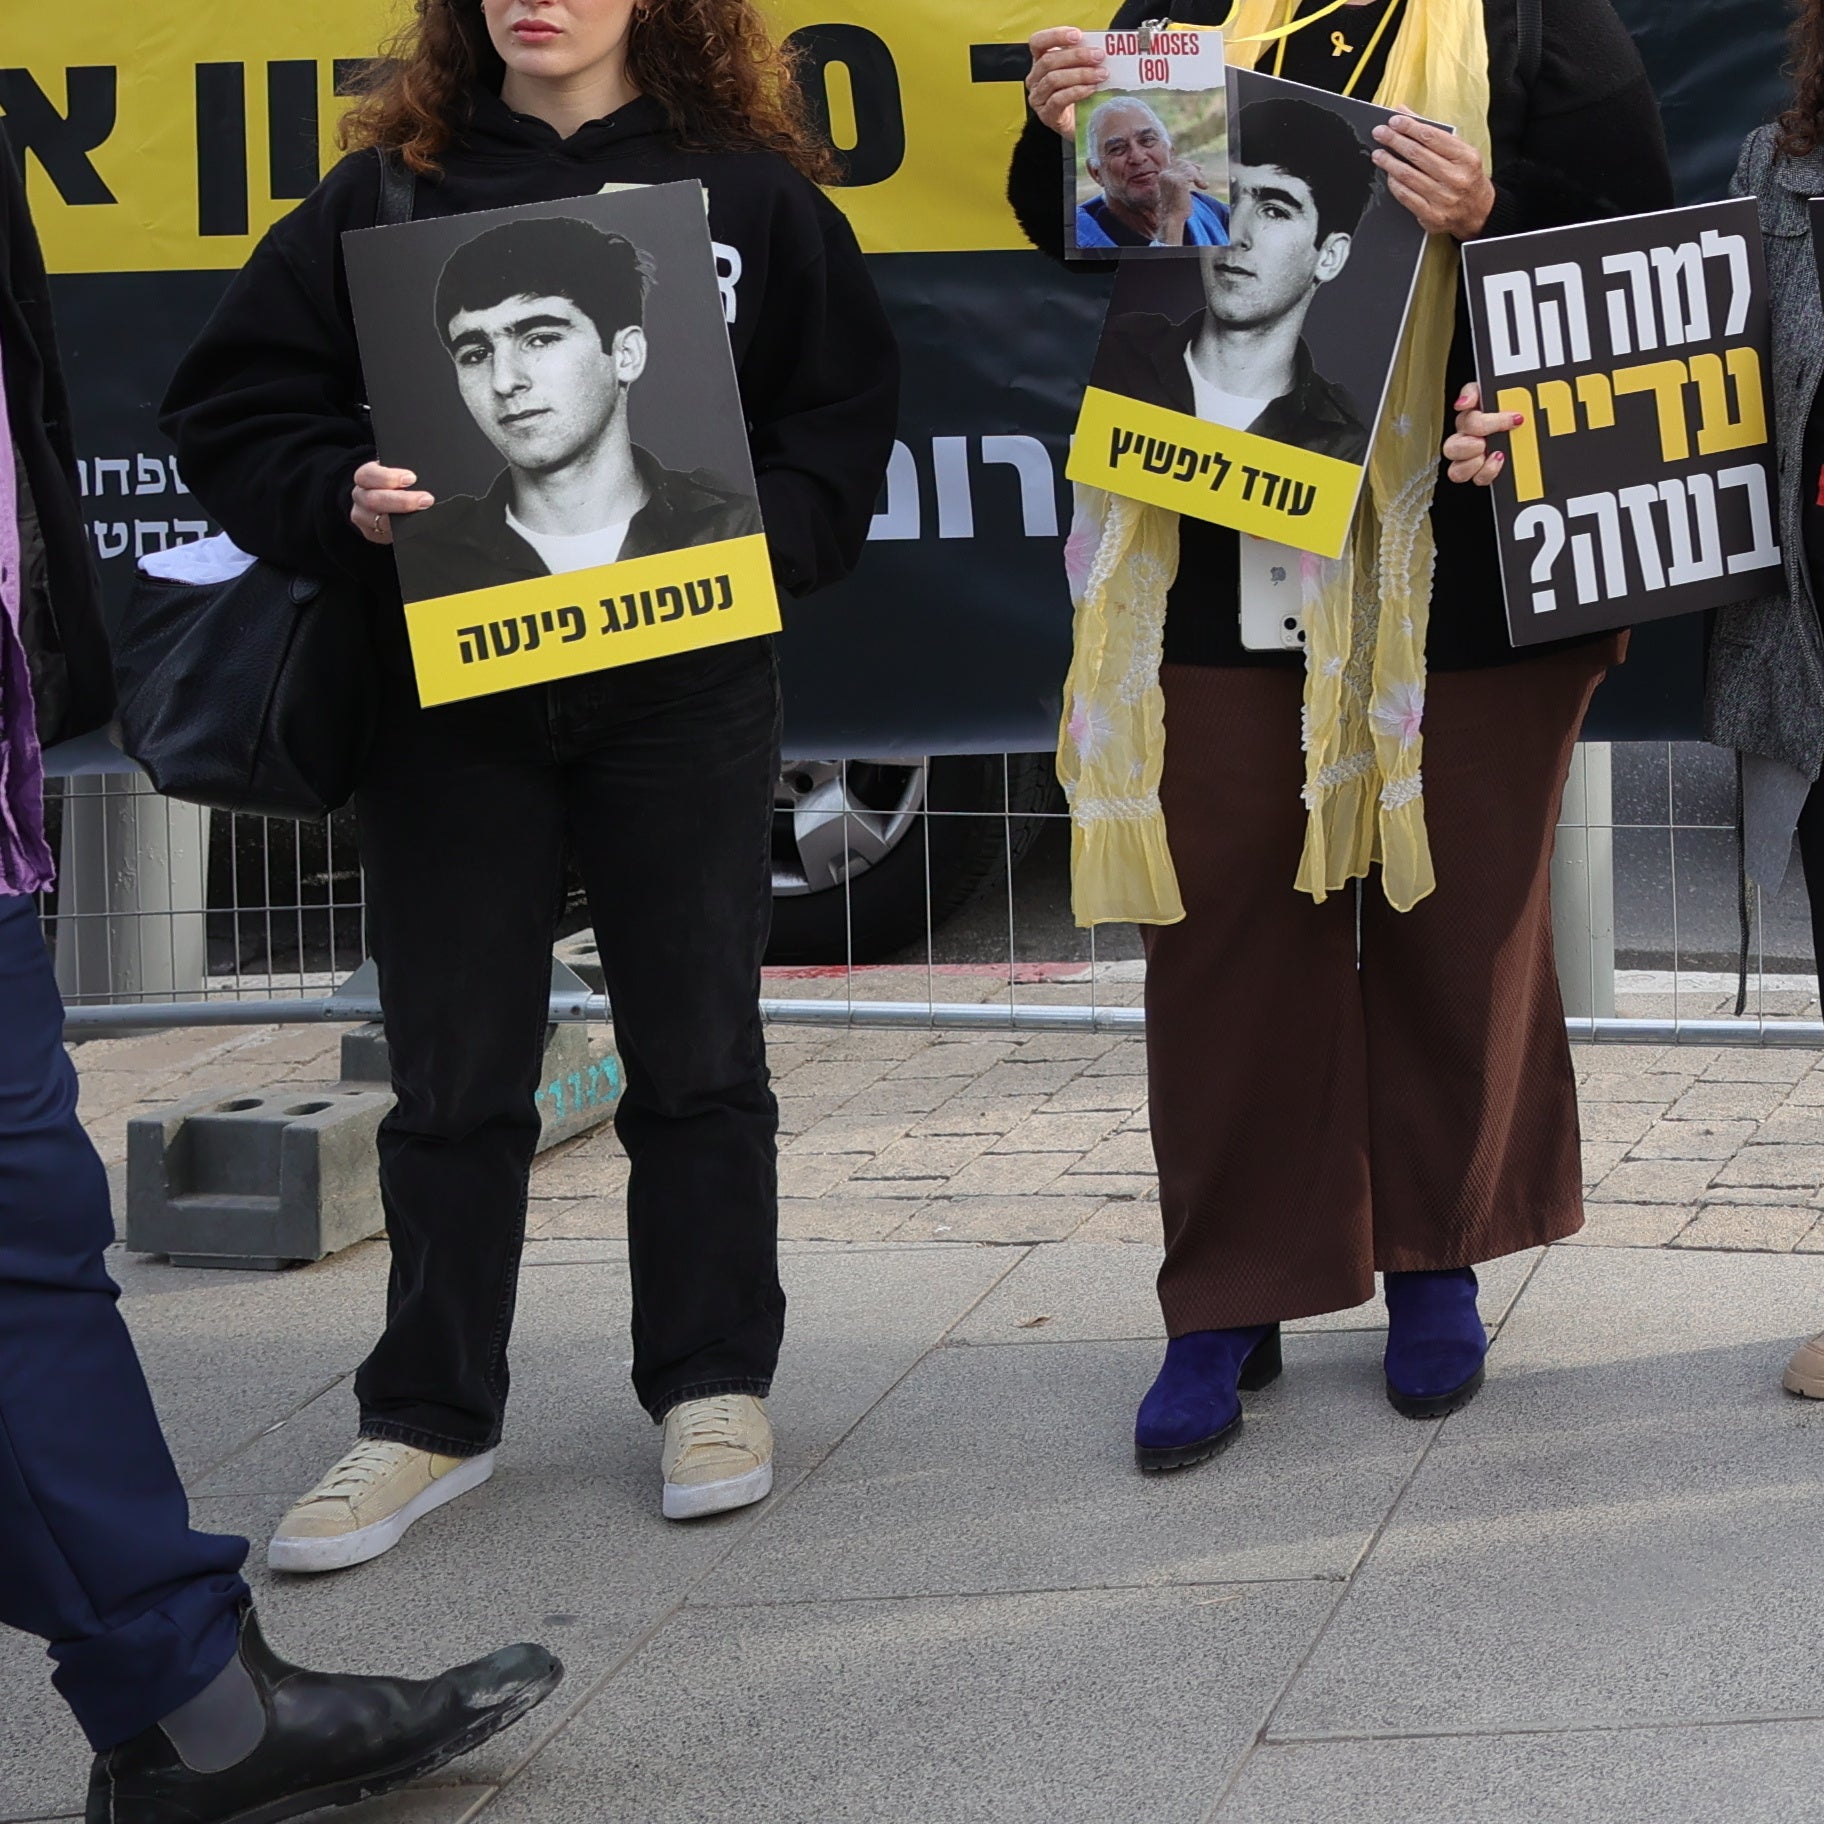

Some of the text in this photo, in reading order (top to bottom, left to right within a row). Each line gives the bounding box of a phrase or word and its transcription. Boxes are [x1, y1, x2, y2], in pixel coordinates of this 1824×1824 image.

[1138, 58, 1169, 84] (80)
[1482, 229, 1752, 376] למה הם
[1109, 427, 1317, 516] עודד ליפשיץ
[1496, 346, 1768, 503] עדיין
[1513, 463, 1781, 614] בעזה?
[456, 574, 734, 664] נטפונג פינטה
